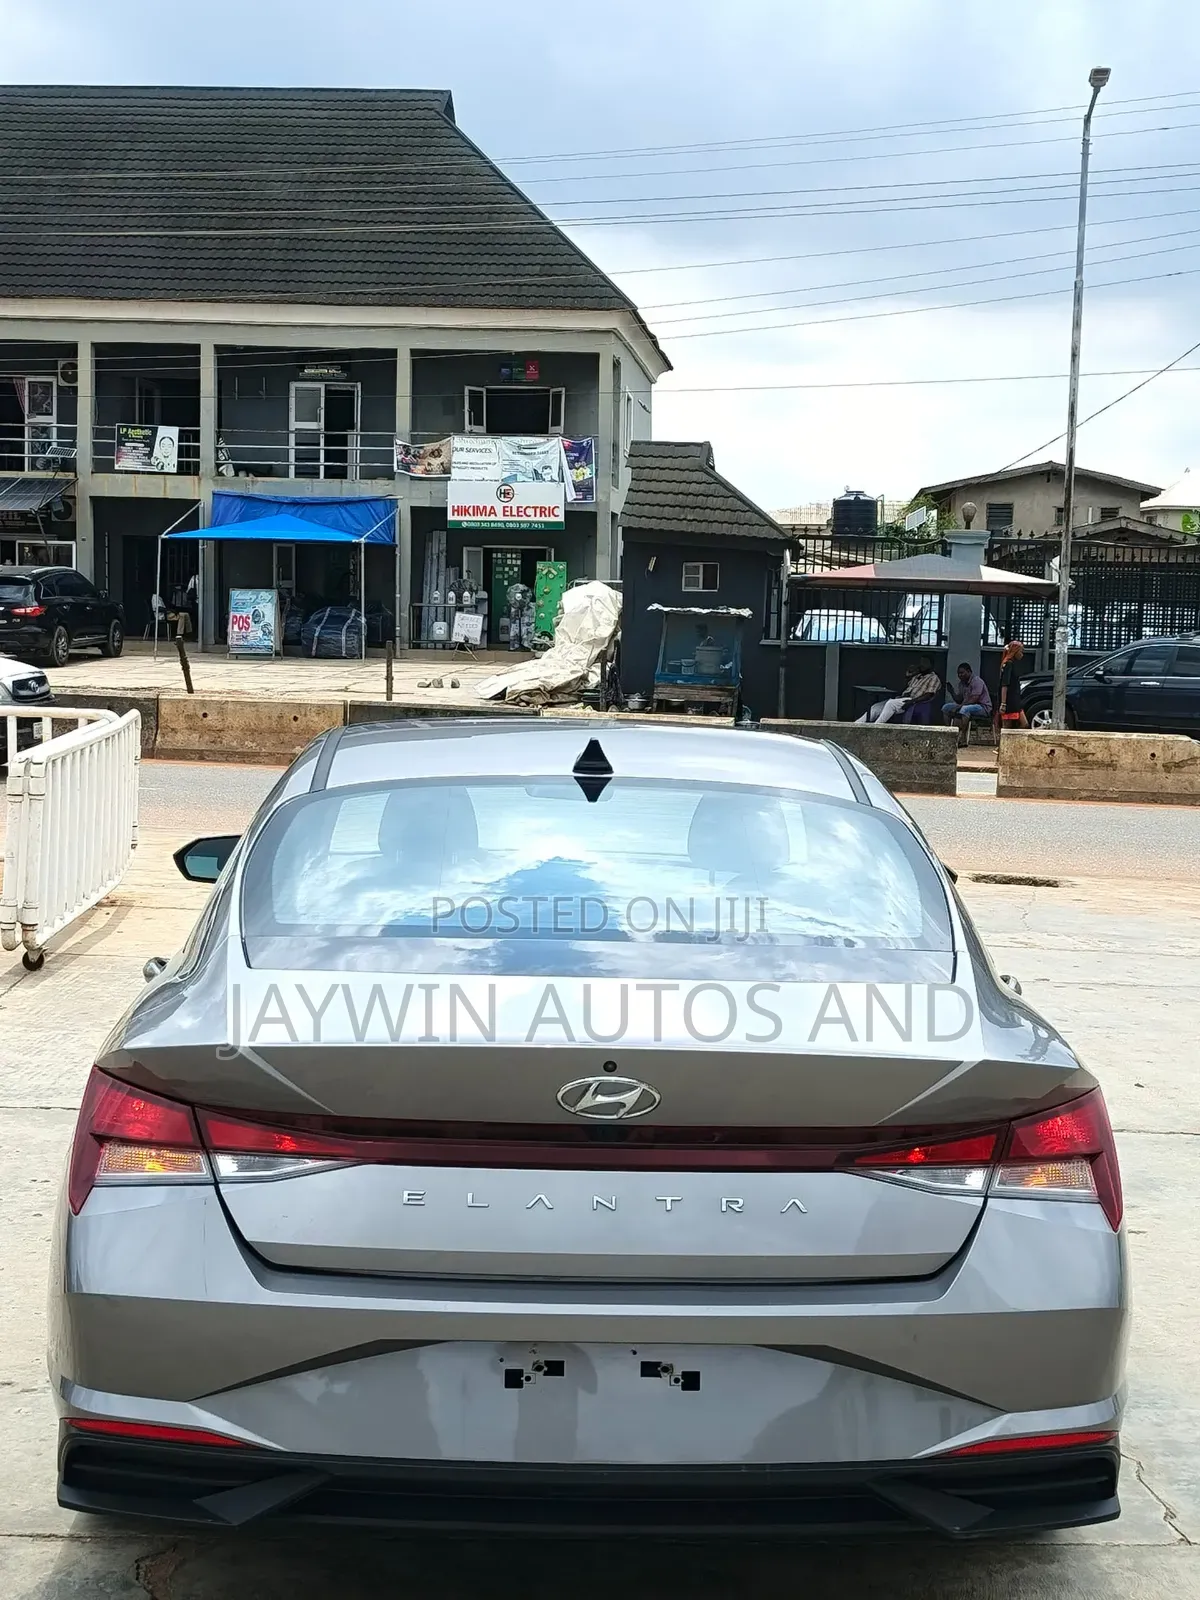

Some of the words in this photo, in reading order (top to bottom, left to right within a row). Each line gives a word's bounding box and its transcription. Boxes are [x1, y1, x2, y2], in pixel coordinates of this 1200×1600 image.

[502, 506, 560, 518] ELECTRIC
[232, 614, 250, 631] POS
[402, 1190, 808, 1214] ELANTRA
